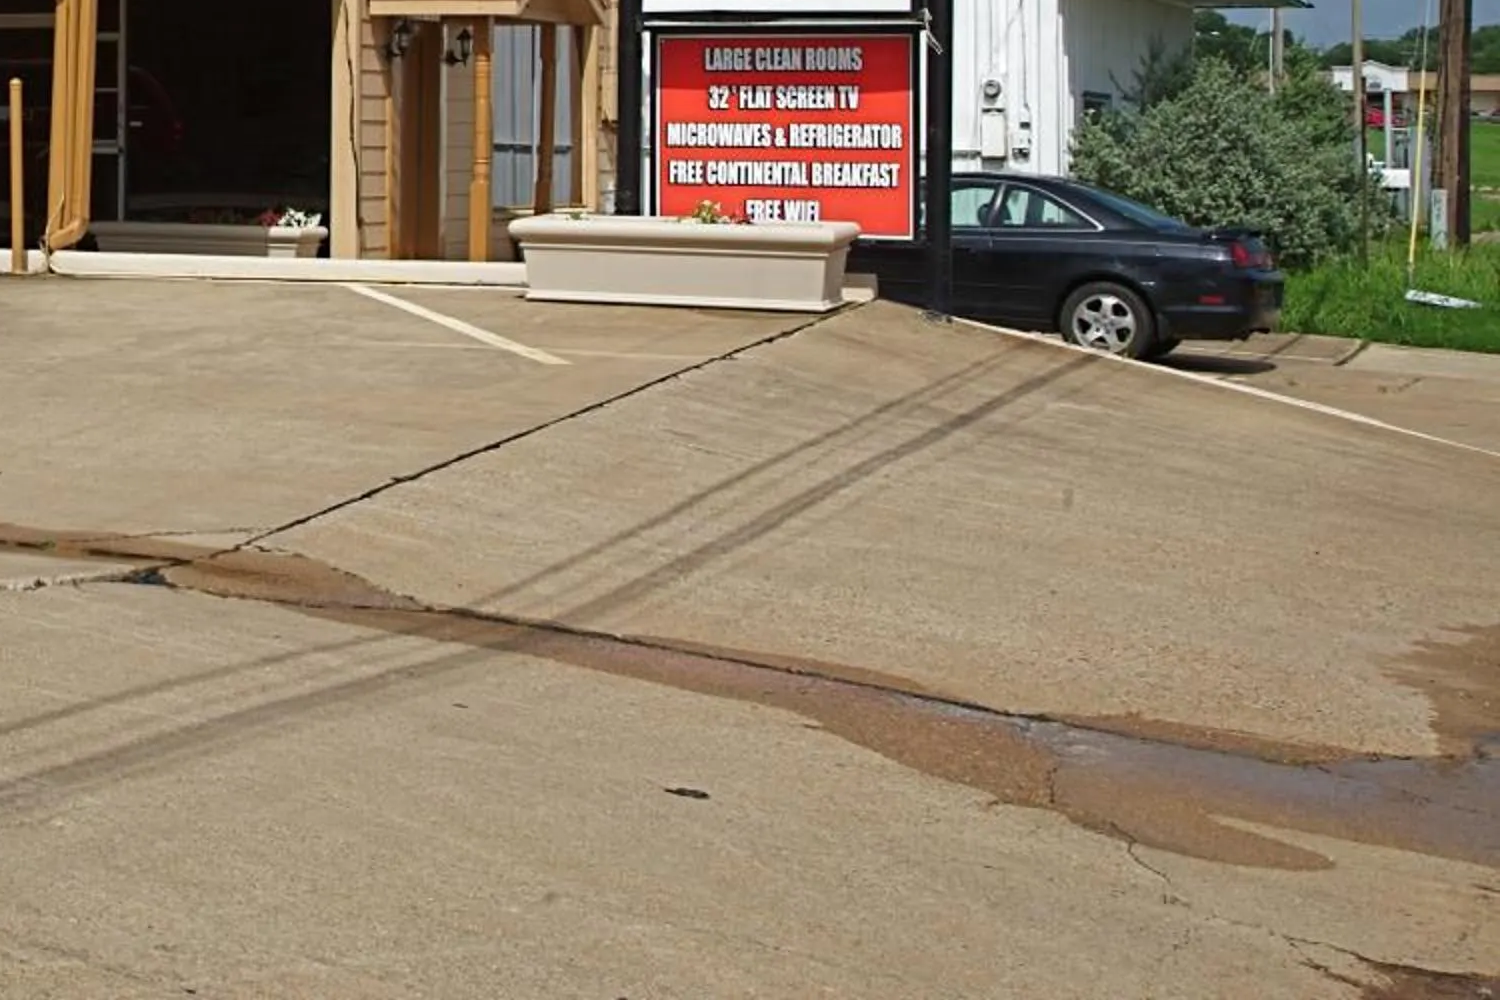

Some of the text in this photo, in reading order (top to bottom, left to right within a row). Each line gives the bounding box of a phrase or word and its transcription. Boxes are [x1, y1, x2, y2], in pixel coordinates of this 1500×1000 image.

[705, 48, 863, 71] LARGE CLEAN ROOMS
[739, 86, 773, 109] FLAT
[775, 86, 835, 109] SCREEN
[838, 86, 860, 109] TV
[667, 123, 902, 149] MICROWAVES & REFRIGERATOR
[669, 161, 901, 187] FREE CONTINENTAL BREAKFAST
[745, 199, 784, 222] FREE
